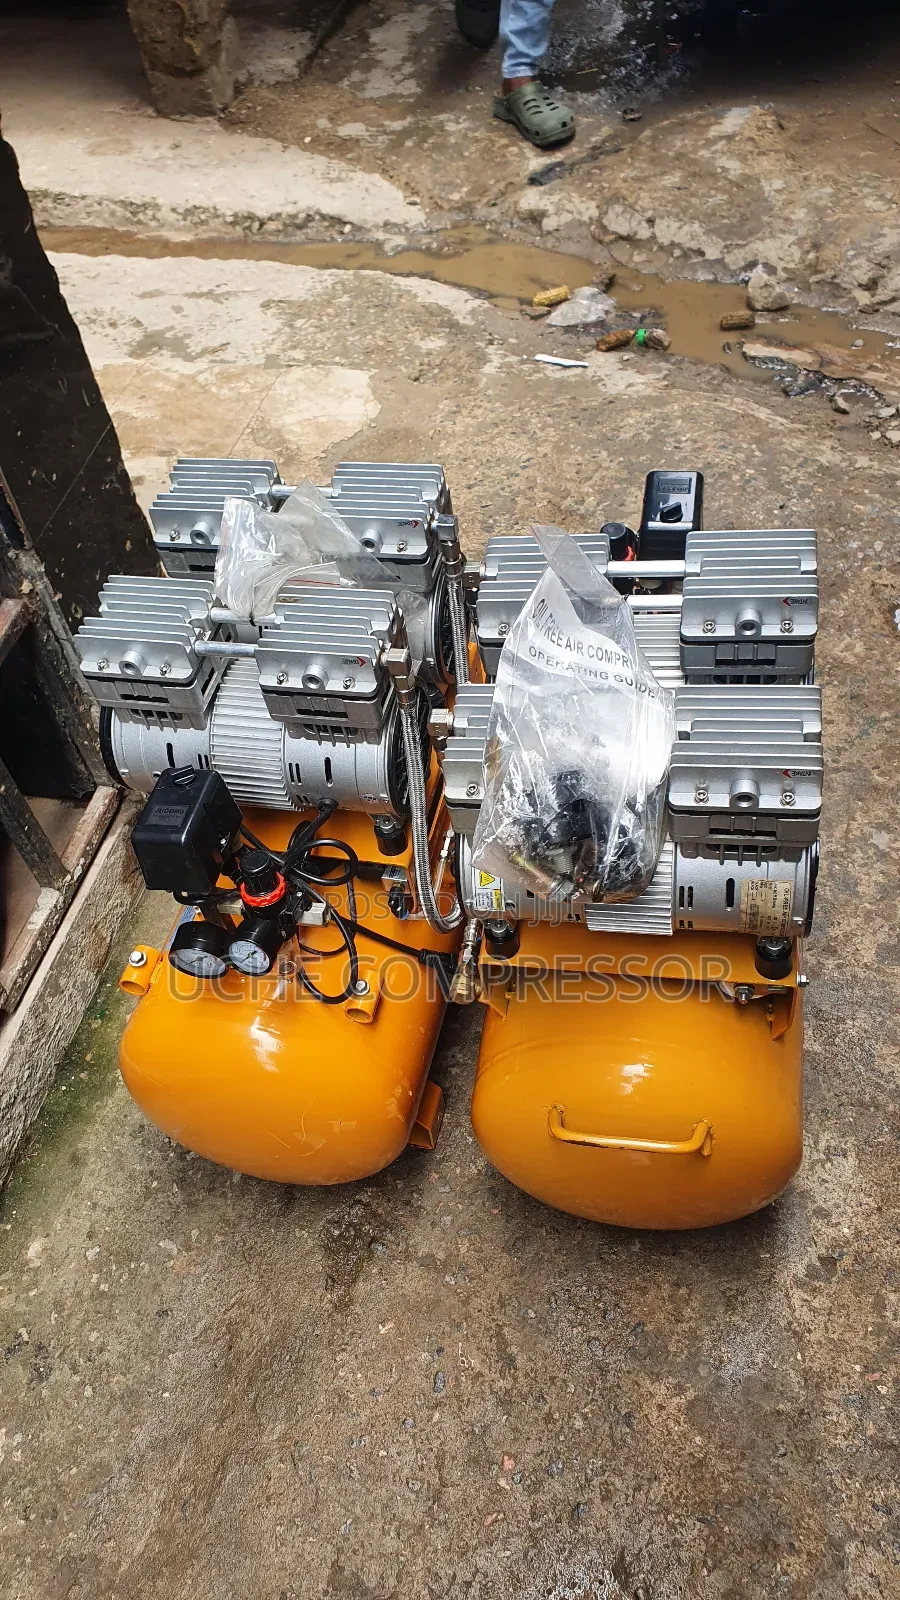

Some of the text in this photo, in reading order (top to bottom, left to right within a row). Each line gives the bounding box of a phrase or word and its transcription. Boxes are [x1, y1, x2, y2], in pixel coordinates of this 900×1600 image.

[565, 636, 585, 657] AIR
[528, 645, 656, 699] OPERATING GUIDE
